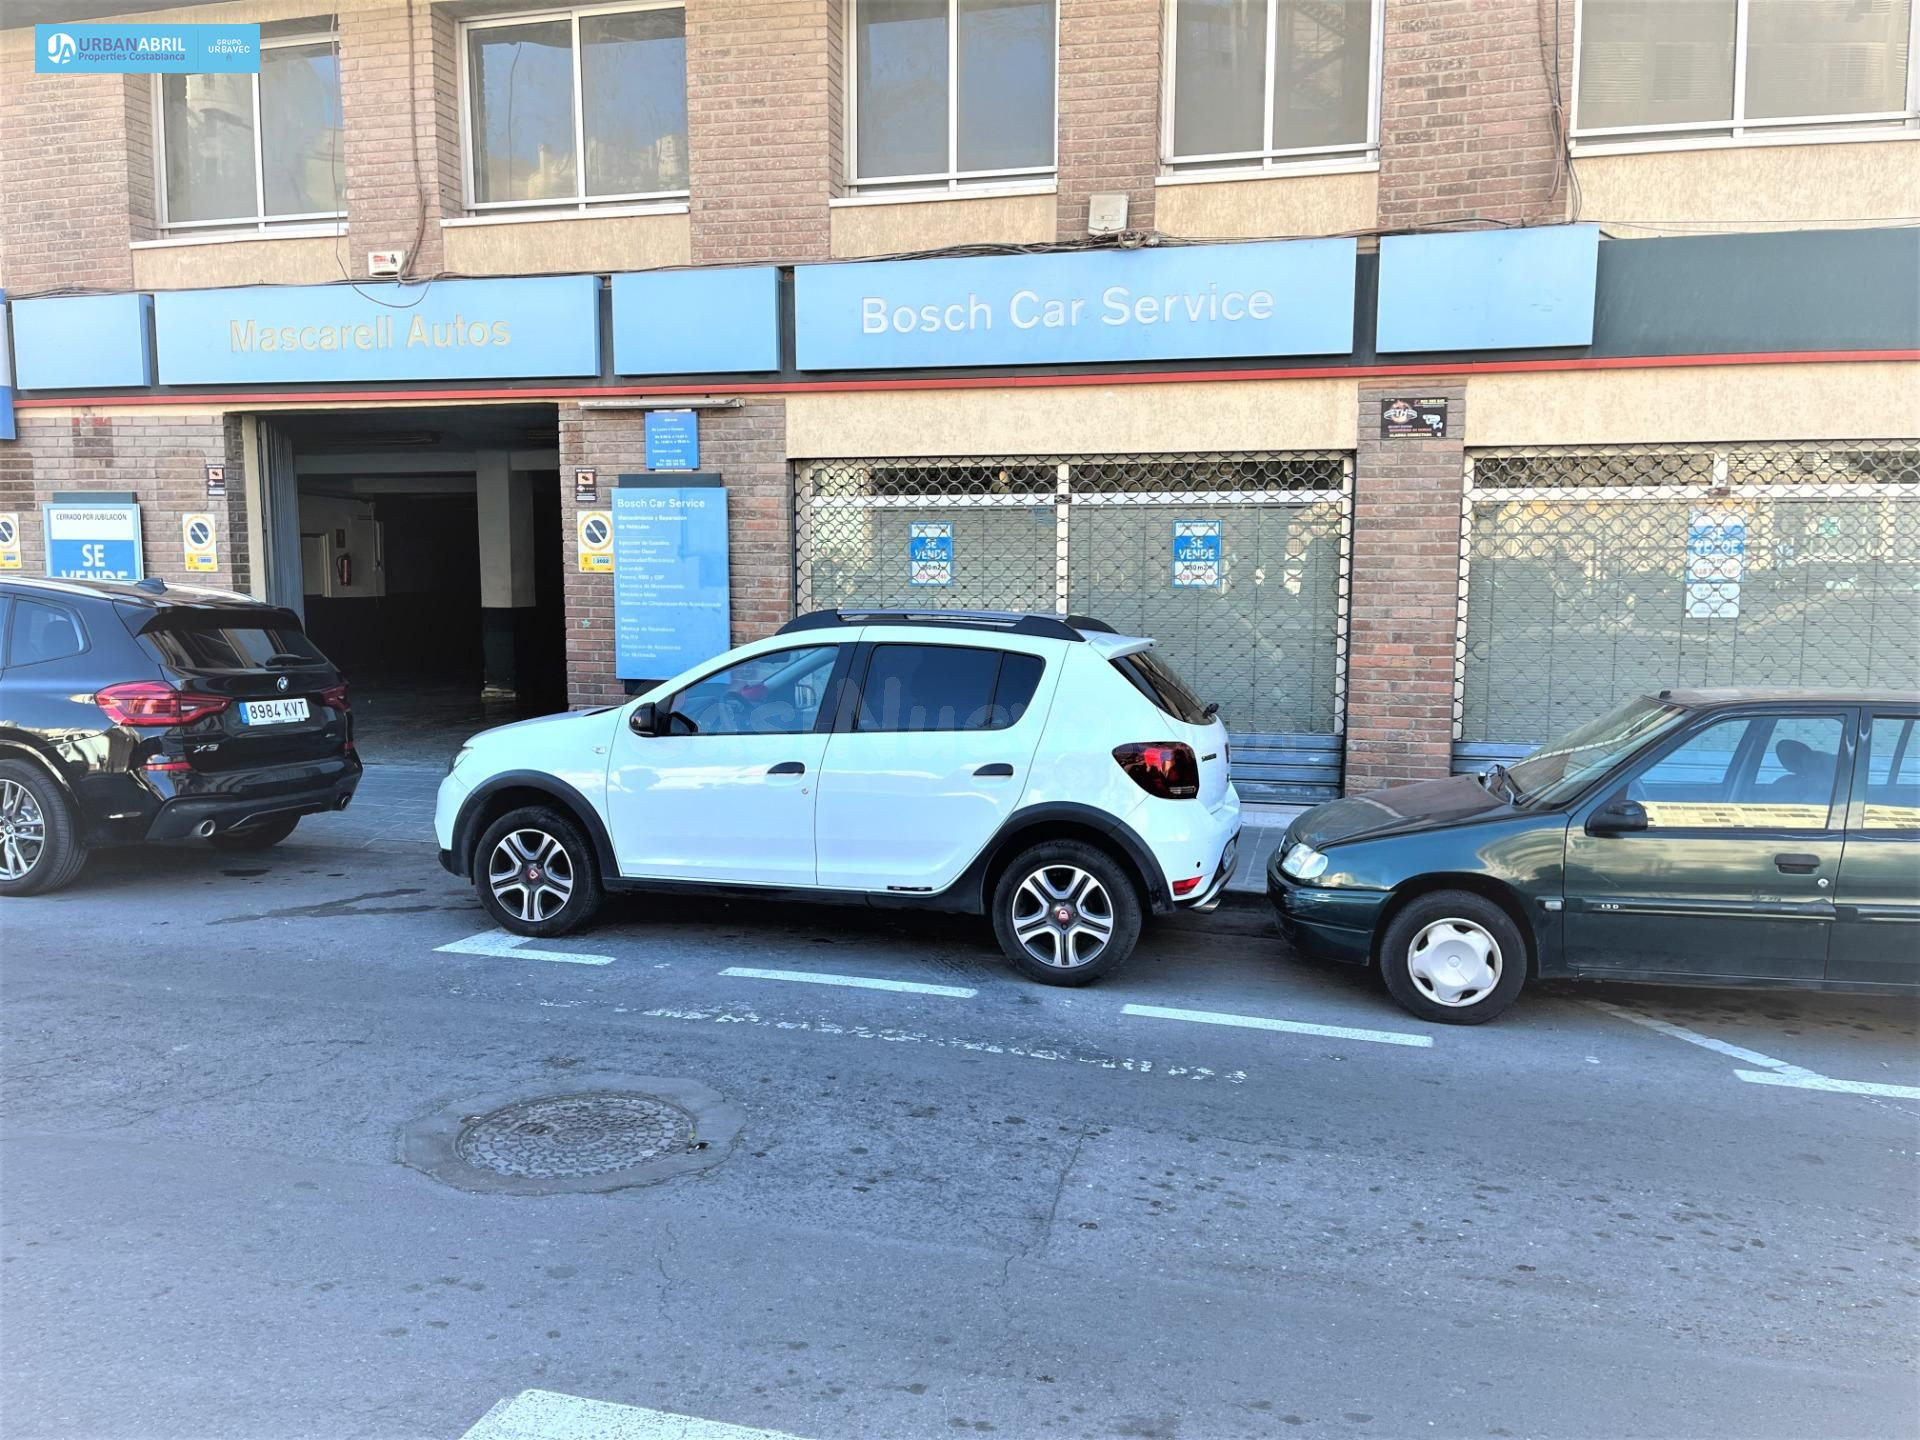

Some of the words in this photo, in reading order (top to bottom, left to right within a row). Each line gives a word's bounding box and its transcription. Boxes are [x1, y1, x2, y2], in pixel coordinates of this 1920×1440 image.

[862, 293, 992, 334] Bosch
[1009, 289, 1085, 330] Car
[1100, 283, 1276, 327] Service
[229, 315, 393, 353] Mascarell
[406, 313, 512, 348] Autos
[617, 498, 647, 508] Bosch
[650, 498, 666, 508] Car
[668, 498, 705, 508] Service
[56, 513, 81, 521] CERRADO
[82, 513, 94, 521] POR
[925, 538, 937, 549] SE
[1191, 537, 1203, 548] SE
[82, 543, 105, 567] SE
[915, 549, 948, 560] VENDE
[1179, 549, 1215, 560] VENDE
[250, 703, 281, 720] 8984
[283, 701, 305, 716] KVT
[193, 743, 219, 753] X3
